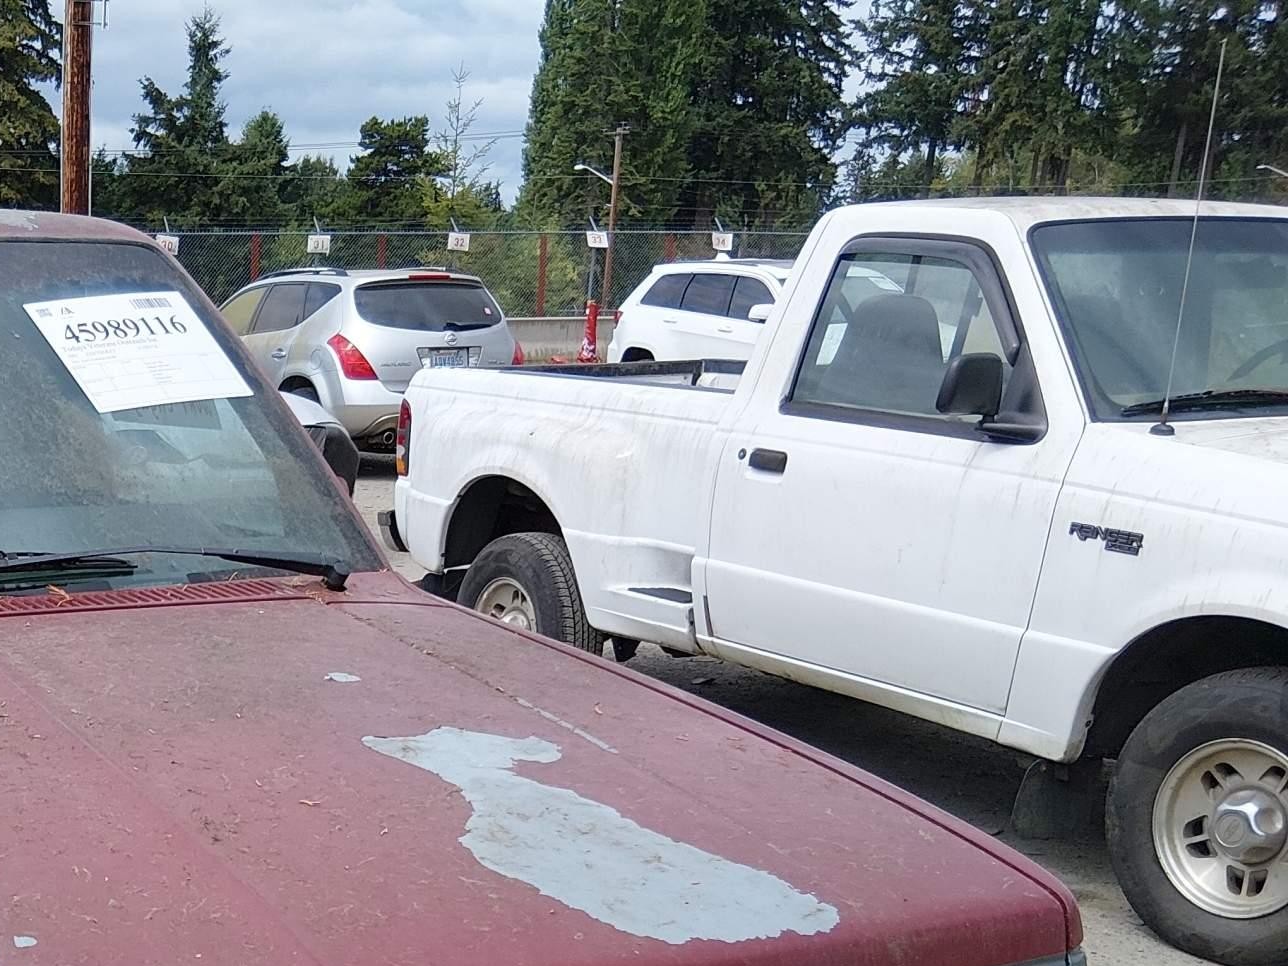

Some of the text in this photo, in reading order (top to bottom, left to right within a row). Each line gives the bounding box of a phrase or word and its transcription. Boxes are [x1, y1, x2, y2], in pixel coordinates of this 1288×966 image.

[454, 237, 465, 248] 32
[591, 235, 602, 244] 33
[64, 315, 187, 343] 45989116
[1068, 521, 1144, 548] RANGER
